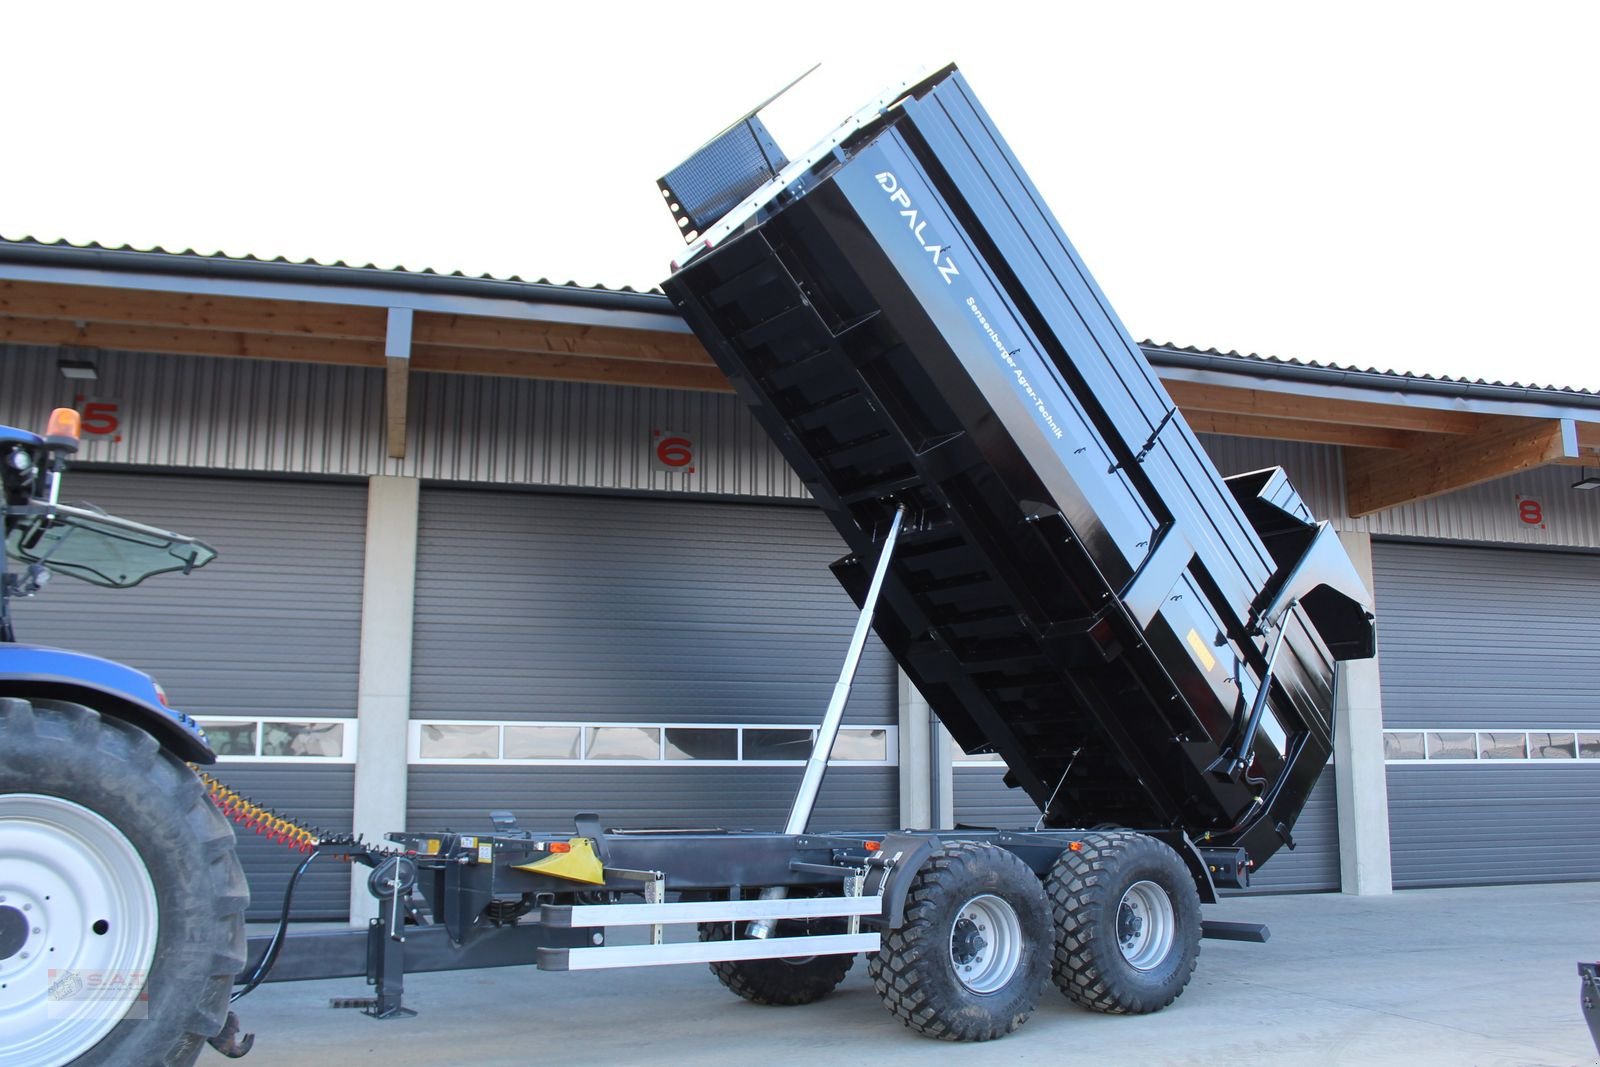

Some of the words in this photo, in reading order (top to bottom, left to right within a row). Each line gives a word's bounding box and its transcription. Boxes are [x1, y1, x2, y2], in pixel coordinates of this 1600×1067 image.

[966, 296, 1017, 370] Sensenberger
[1014, 369, 1064, 440] Agrar-Technik
[81, 402, 118, 435] 5
[656, 437, 693, 467] 6
[1519, 499, 1544, 525] 8
